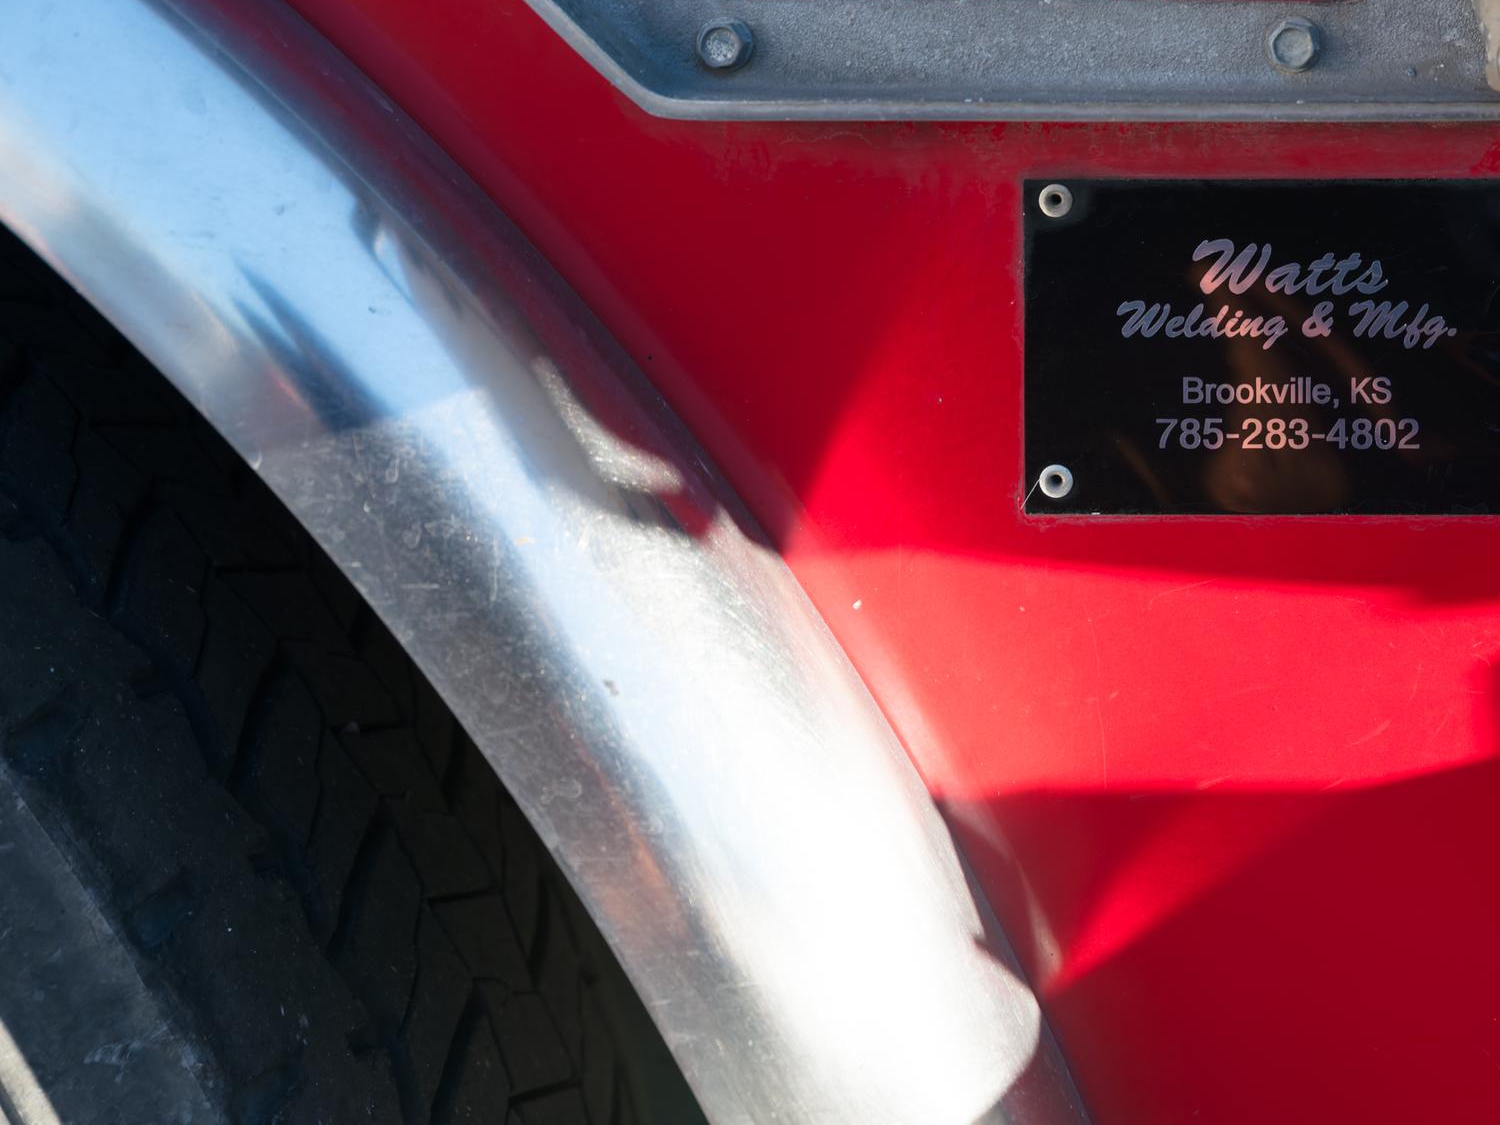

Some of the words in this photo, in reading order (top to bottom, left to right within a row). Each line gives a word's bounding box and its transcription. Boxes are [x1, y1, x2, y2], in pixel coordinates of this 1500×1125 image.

[1193, 239, 1388, 295] Watts
[1117, 300, 1288, 350] Welding
[1302, 302, 1333, 337] &
[1349, 300, 1458, 349] Mfg.
[1182, 377, 1339, 409] Brookville,
[1351, 377, 1392, 405] KS
[1156, 418, 1421, 451] 785-283-4802
